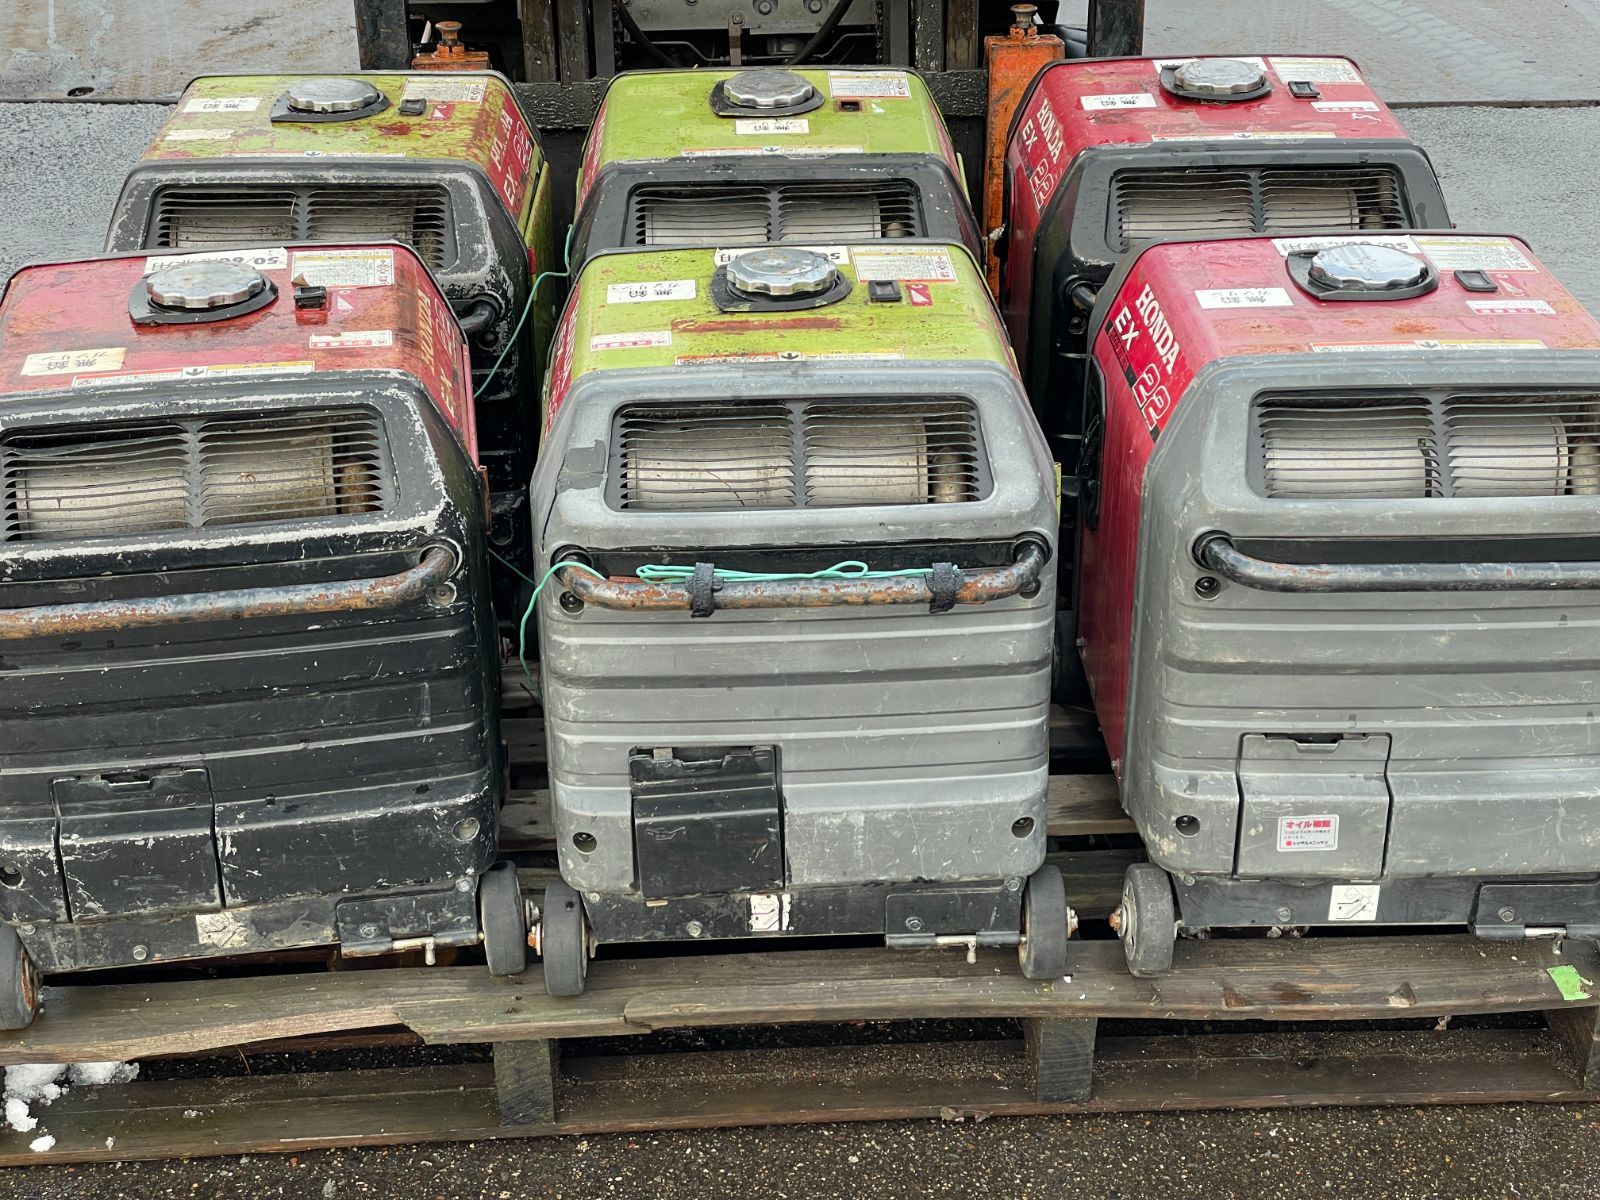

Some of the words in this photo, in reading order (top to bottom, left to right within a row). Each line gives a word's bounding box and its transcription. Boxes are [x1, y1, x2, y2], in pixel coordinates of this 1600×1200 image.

[490, 108, 513, 173] HODA
[1022, 118, 1038, 153] EX
[1036, 97, 1064, 165] HONDA
[1029, 157, 1055, 210] 22
[1135, 283, 1180, 376] HONDA
[1114, 306, 1140, 351] EX
[1132, 363, 1171, 431] 22
